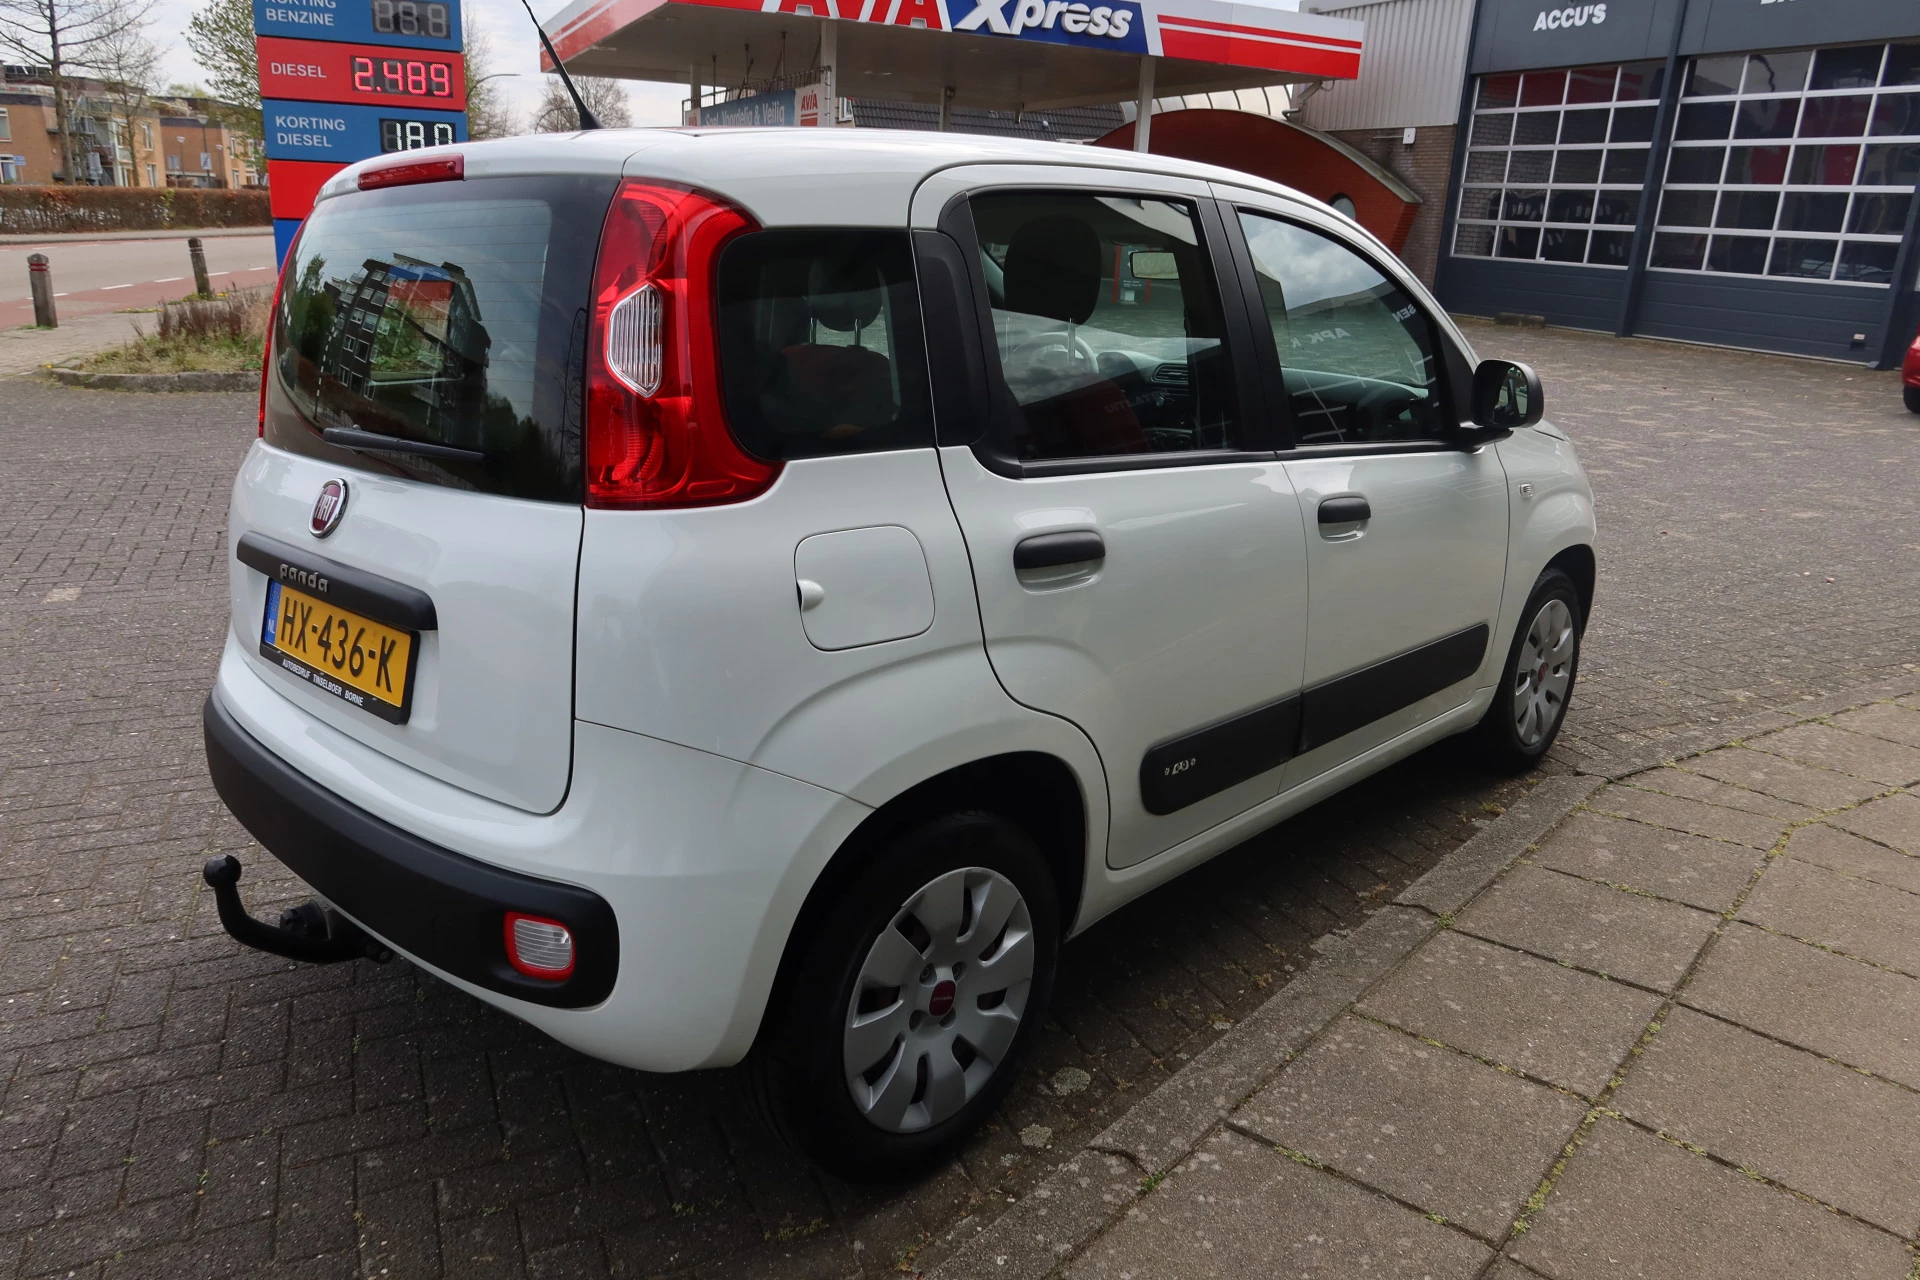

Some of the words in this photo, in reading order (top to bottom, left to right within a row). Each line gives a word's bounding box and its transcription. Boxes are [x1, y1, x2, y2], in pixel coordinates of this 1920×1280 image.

[265, 8, 335, 26] BENZINE
[953, 0, 1133, 39] Xpress
[1533, 3, 1607, 31] ACCU'S
[270, 62, 327, 79] DIESEL
[354, 57, 450, 97] 2.489
[754, 104, 761, 125] &
[762, 100, 785, 126] Veilig
[801, 93, 818, 111] AVIA
[275, 115, 346, 132] KORTING
[277, 132, 333, 148] DIESEL
[314, 494, 338, 522] FIAT
[280, 563, 328, 593] panda
[268, 618, 275, 634] NL
[281, 597, 397, 693] HX-436-K
[344, 689, 364, 707] BORNE
